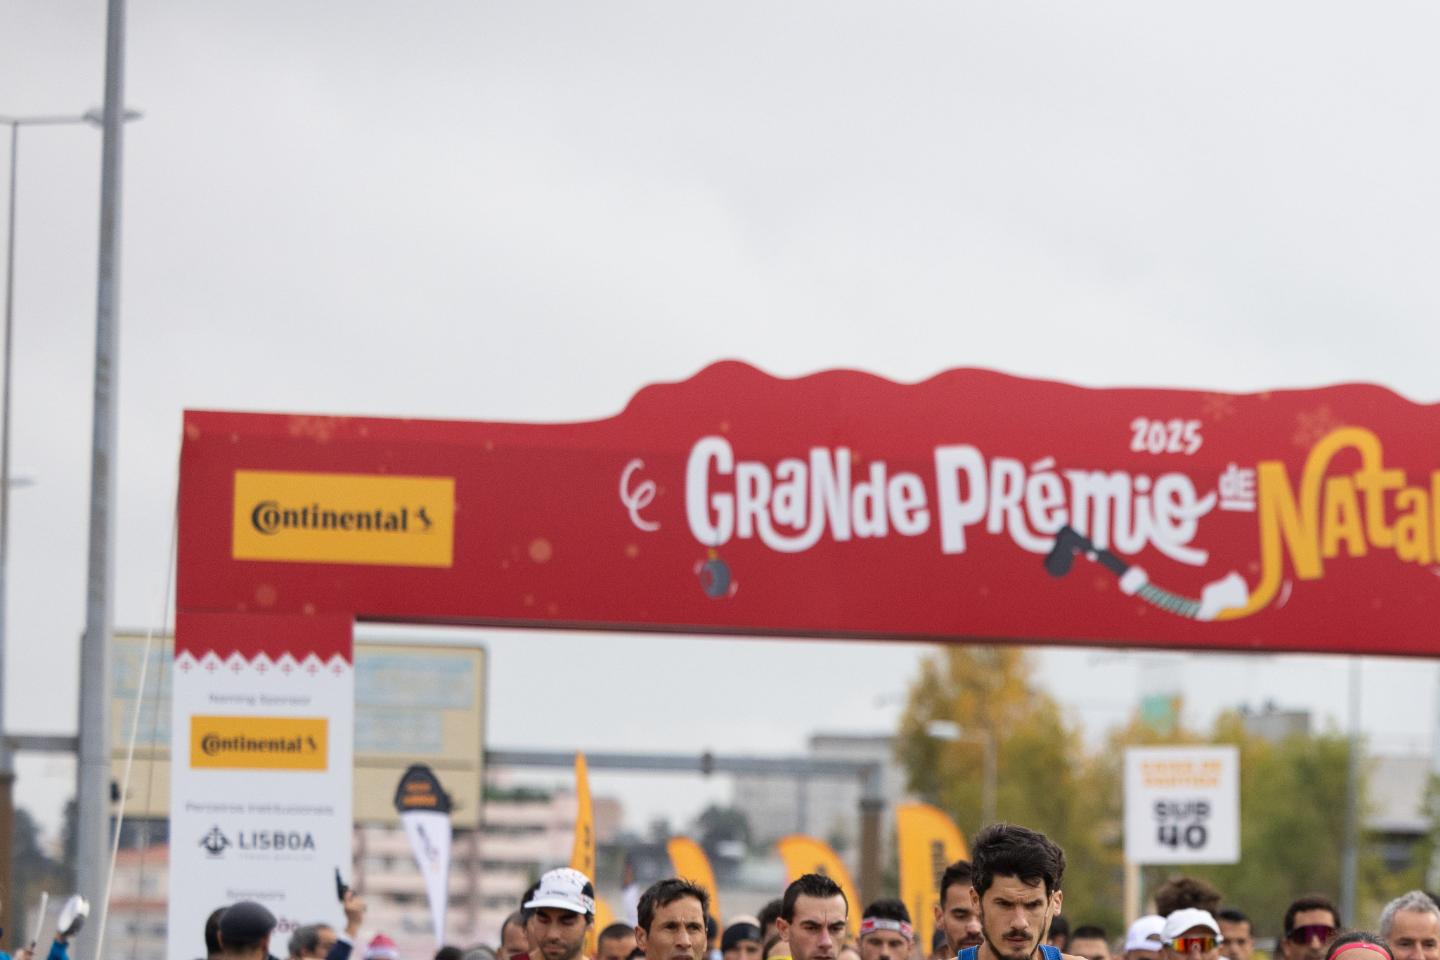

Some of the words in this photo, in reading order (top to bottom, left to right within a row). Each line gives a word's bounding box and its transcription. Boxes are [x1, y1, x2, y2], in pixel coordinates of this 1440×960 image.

[1129, 416, 1203, 455] 2025
[251, 499, 408, 536] Continental
[201, 733, 302, 756] Continental
[238, 831, 316, 851] LISBOA
[1158, 824, 1208, 850] 40
